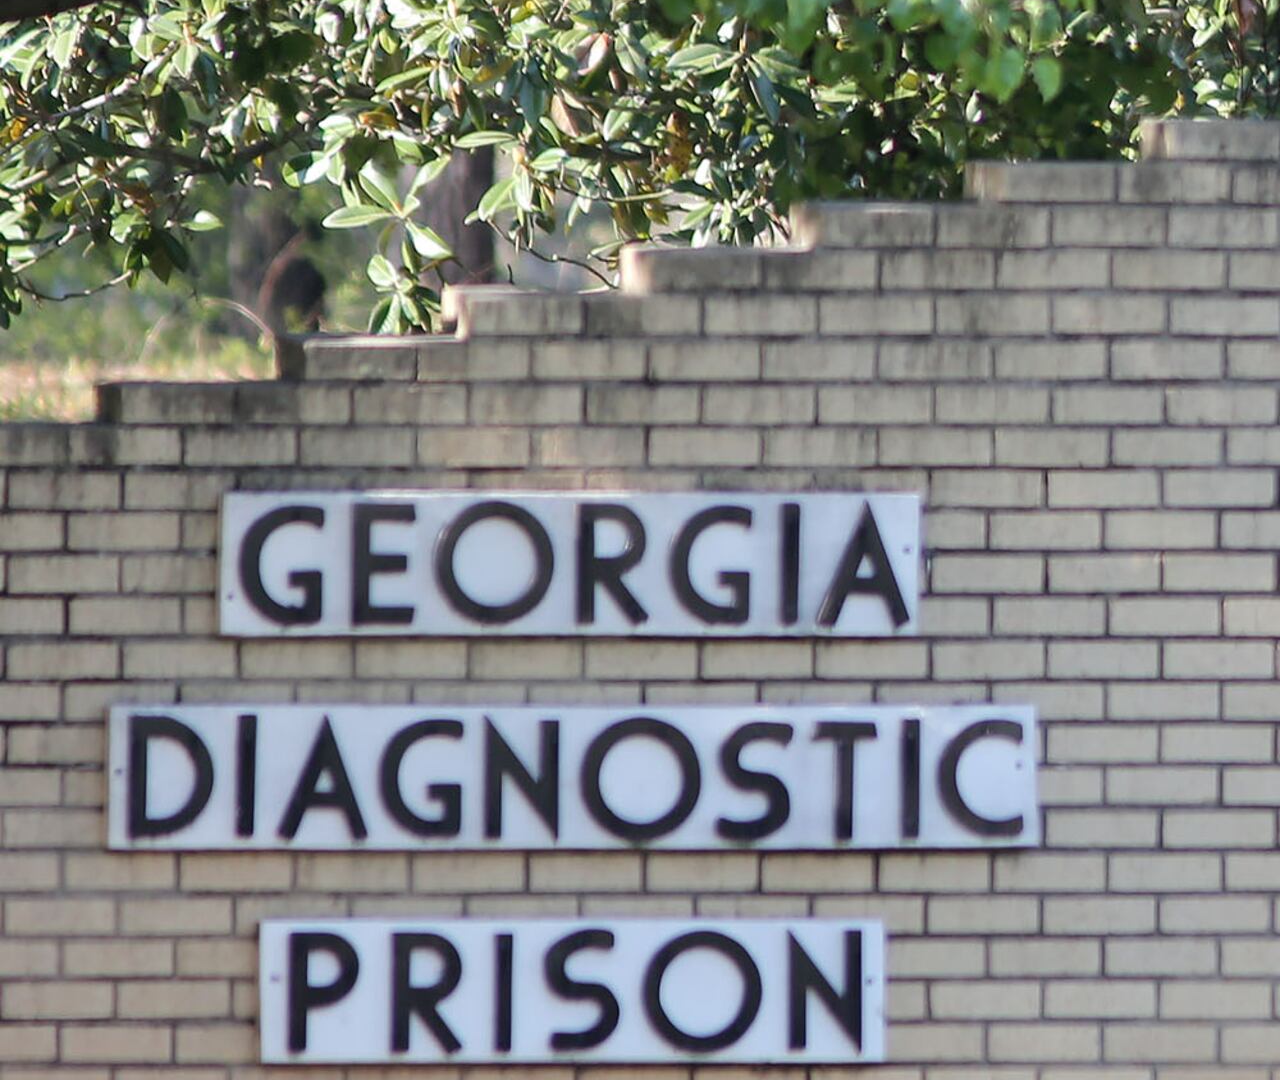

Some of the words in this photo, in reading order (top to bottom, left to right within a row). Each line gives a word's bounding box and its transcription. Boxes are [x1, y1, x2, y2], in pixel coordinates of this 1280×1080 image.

[238, 500, 910, 629] GEORGIA
[127, 714, 1024, 841] DIAGNOSTIC
[287, 929, 863, 1056] PRISON
